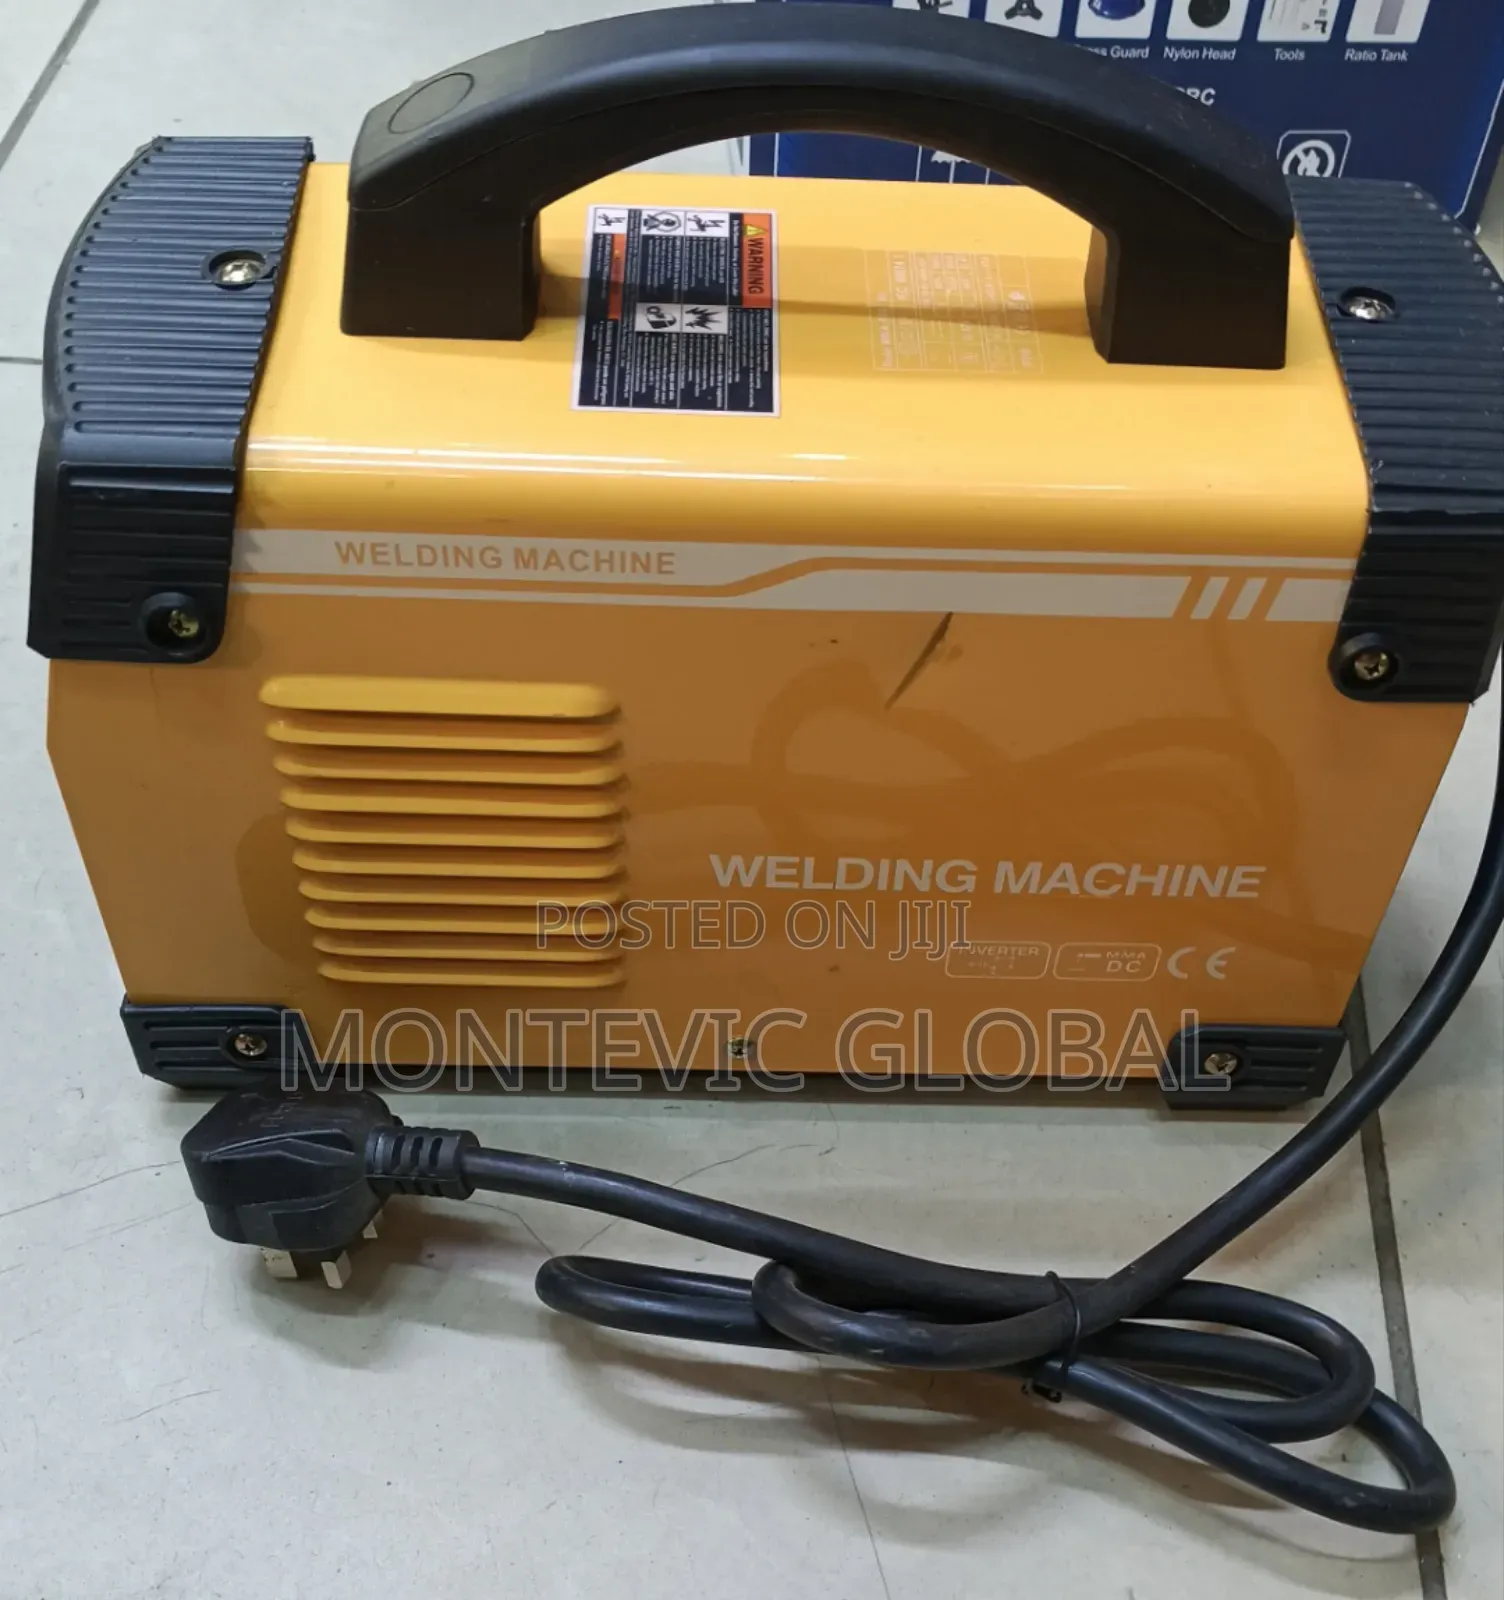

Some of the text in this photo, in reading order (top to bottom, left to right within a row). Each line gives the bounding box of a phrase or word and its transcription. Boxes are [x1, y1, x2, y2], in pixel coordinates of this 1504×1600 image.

[1110, 45, 1150, 59] Guard
[1163, 46, 1237, 62] Nylon Head
[1274, 47, 1305, 61] Tools
[1344, 48, 1408, 61] Ratio Tank
[747, 237, 764, 295] WARNING
[334, 540, 677, 575] WELDING MACHINE
[709, 854, 1267, 899] WELDING MACHINE
[1106, 960, 1142, 973] DC
[1166, 946, 1237, 980] CE
